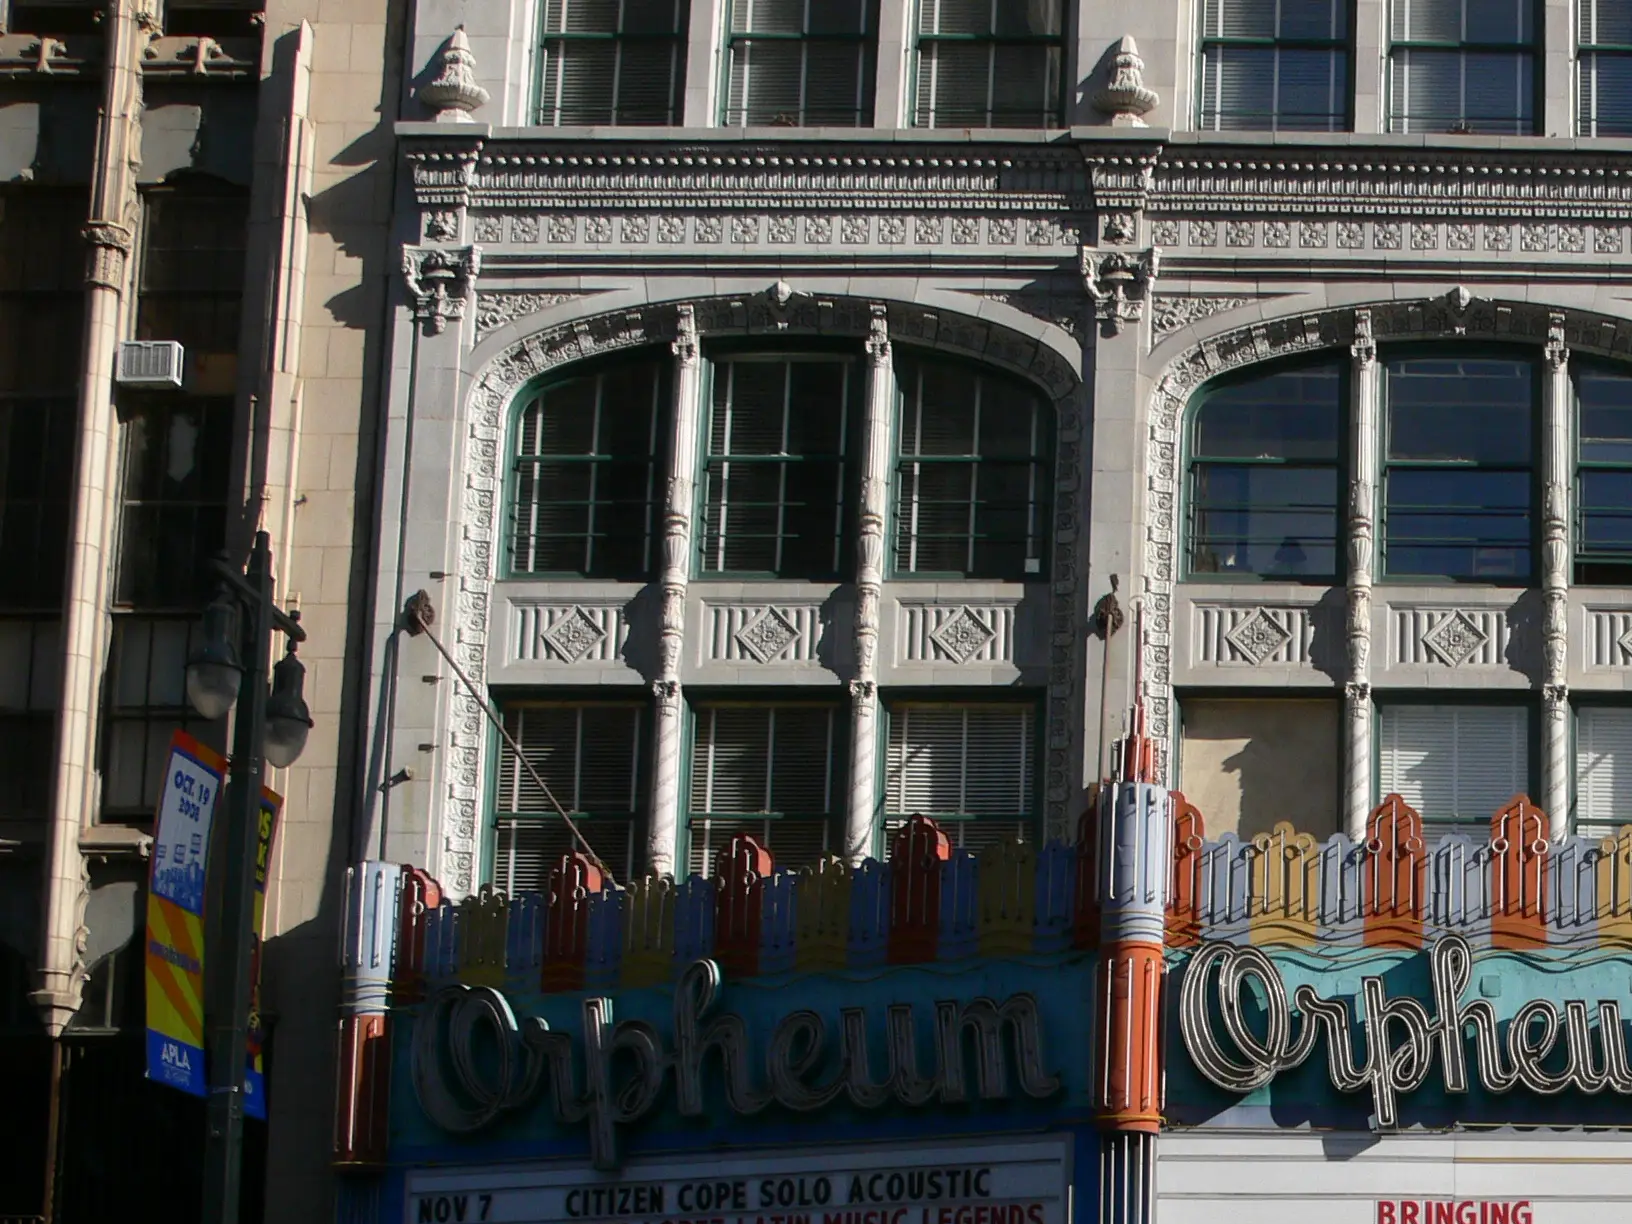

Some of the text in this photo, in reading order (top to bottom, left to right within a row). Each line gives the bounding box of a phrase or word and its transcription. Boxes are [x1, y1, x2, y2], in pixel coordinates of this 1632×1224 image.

[199, 784, 211, 806] 19
[160, 1041, 192, 1071] APLA
[410, 959, 1062, 1169] Orpheum
[418, 1168, 991, 1224] NOV 7 CITIZEN COPE SOLO ACOUSTIC
